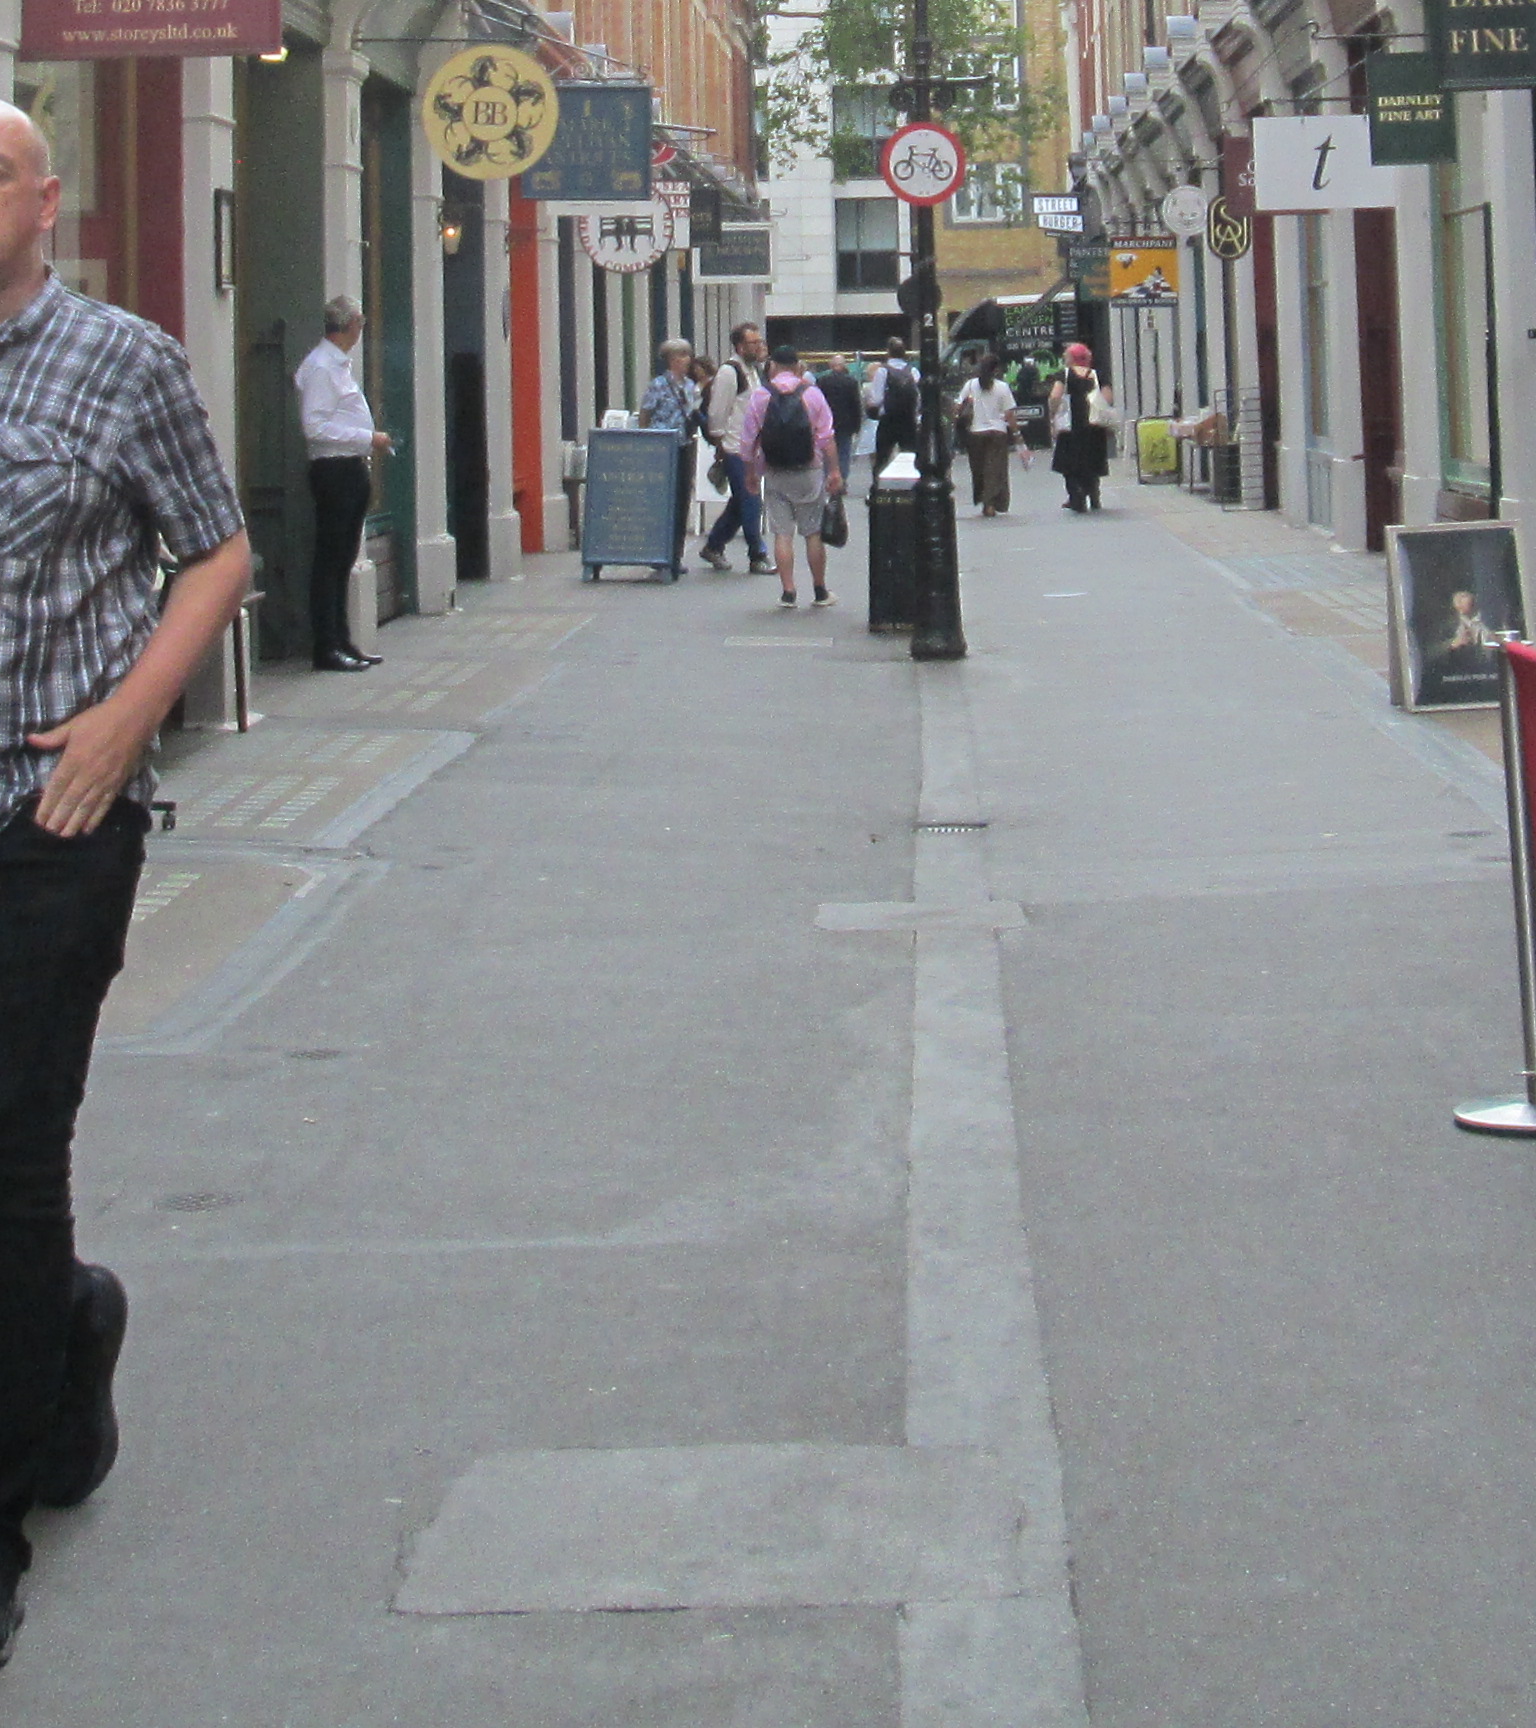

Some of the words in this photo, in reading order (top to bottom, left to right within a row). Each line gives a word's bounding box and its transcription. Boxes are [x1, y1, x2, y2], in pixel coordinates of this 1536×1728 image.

[62, 22, 239, 44] www.storeysltd.co.uk
[1448, 27, 1529, 55] FINE
[1377, 94, 1444, 108] DARNLEY
[472, 101, 509, 126] BB
[1378, 110, 1411, 122] FINE
[1414, 108, 1443, 121] ART
[1312, 133, 1337, 191] t
[1038, 198, 1075, 212] STREET
[1042, 215, 1080, 231] BURGER
[922, 313, 934, 327] 2
